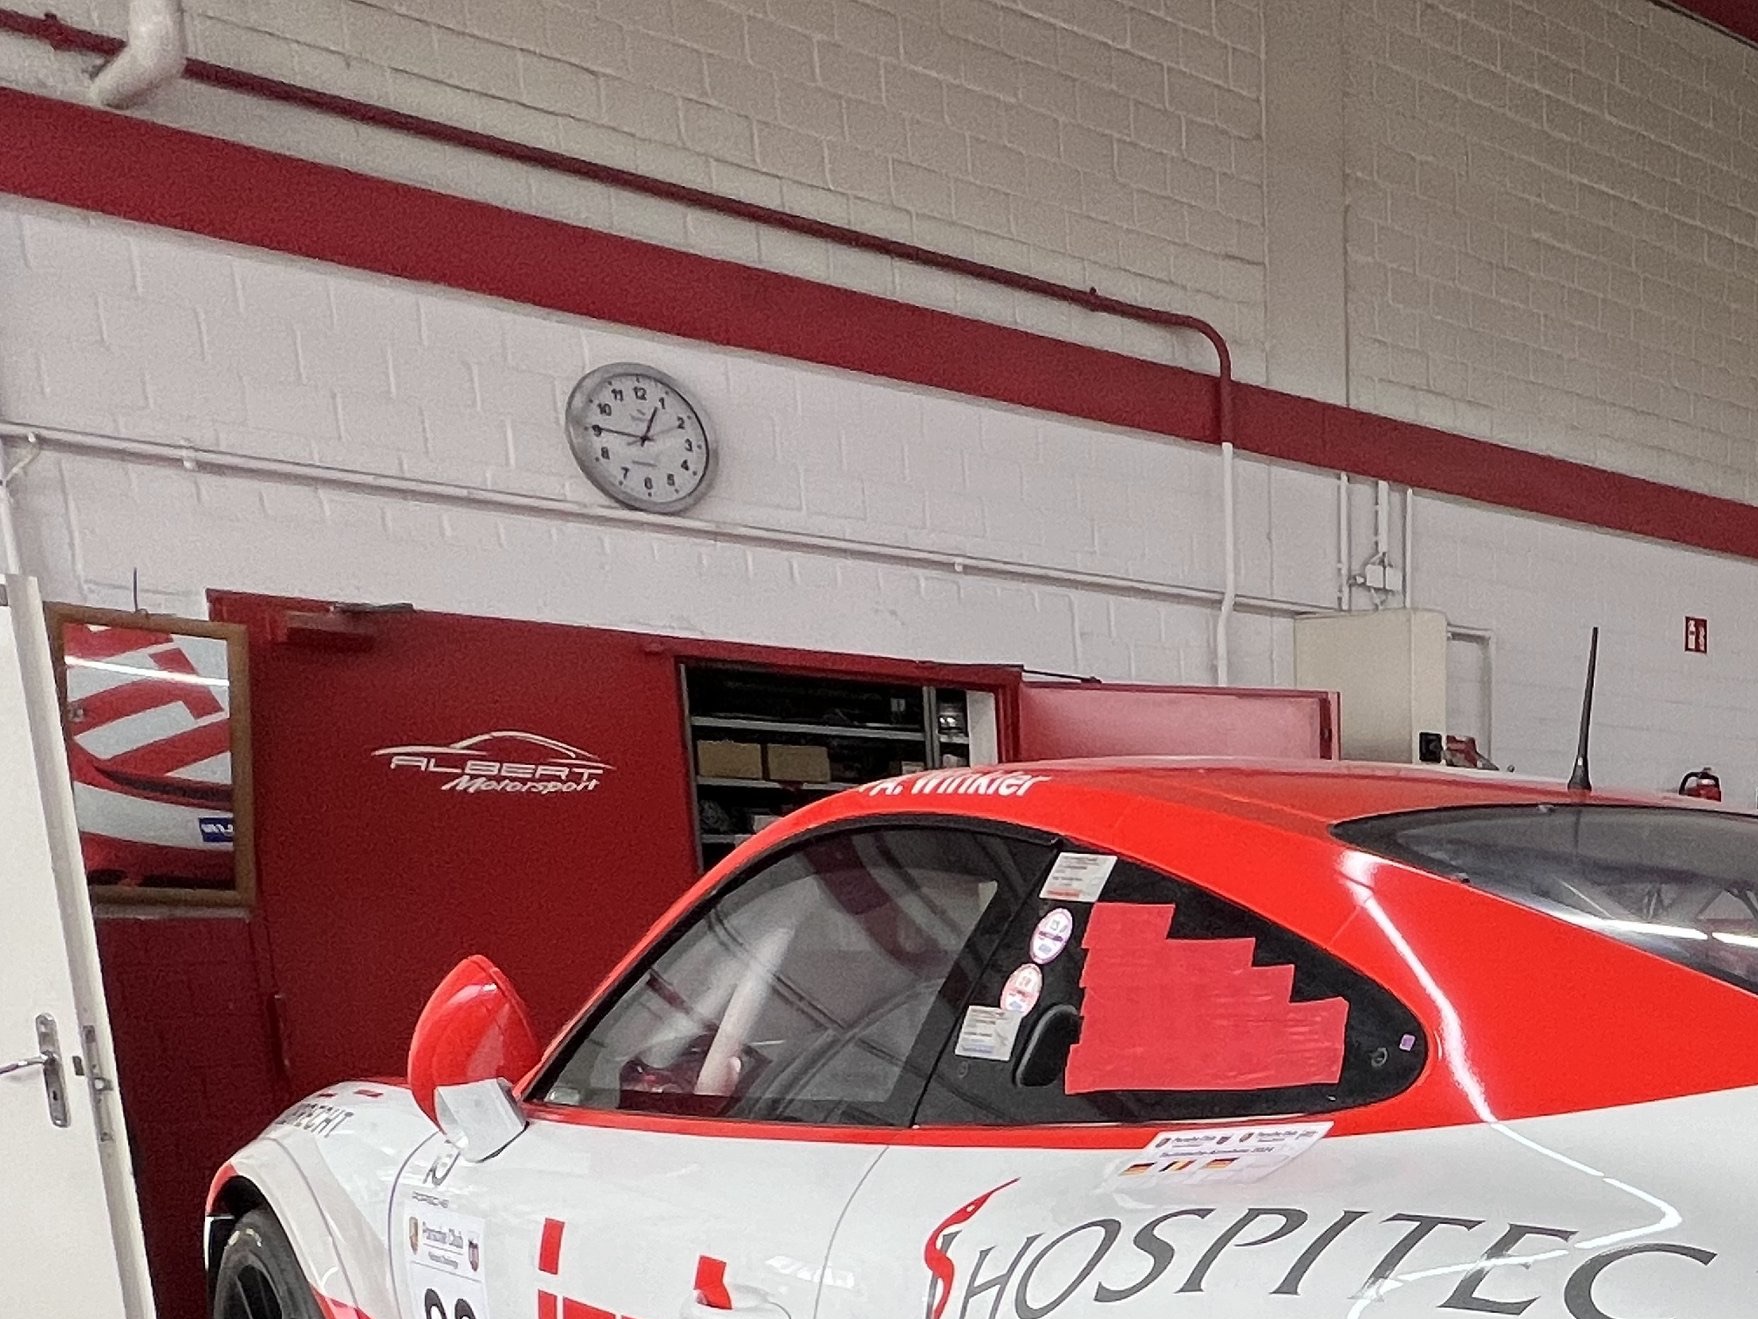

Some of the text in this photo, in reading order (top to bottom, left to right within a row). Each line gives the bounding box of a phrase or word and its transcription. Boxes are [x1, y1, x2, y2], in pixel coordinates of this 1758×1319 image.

[611, 388, 624, 402] 11
[633, 386, 647, 401] 12
[598, 403, 612, 416] 10
[659, 397, 666, 409] 1
[677, 416, 685, 429] 2
[685, 438, 693, 452] 3
[681, 459, 690, 471] 4
[621, 467, 630, 480] 7
[667, 474, 675, 487] 5
[390, 756, 603, 781] ALBERT
[441, 775, 600, 794] Motorsport
